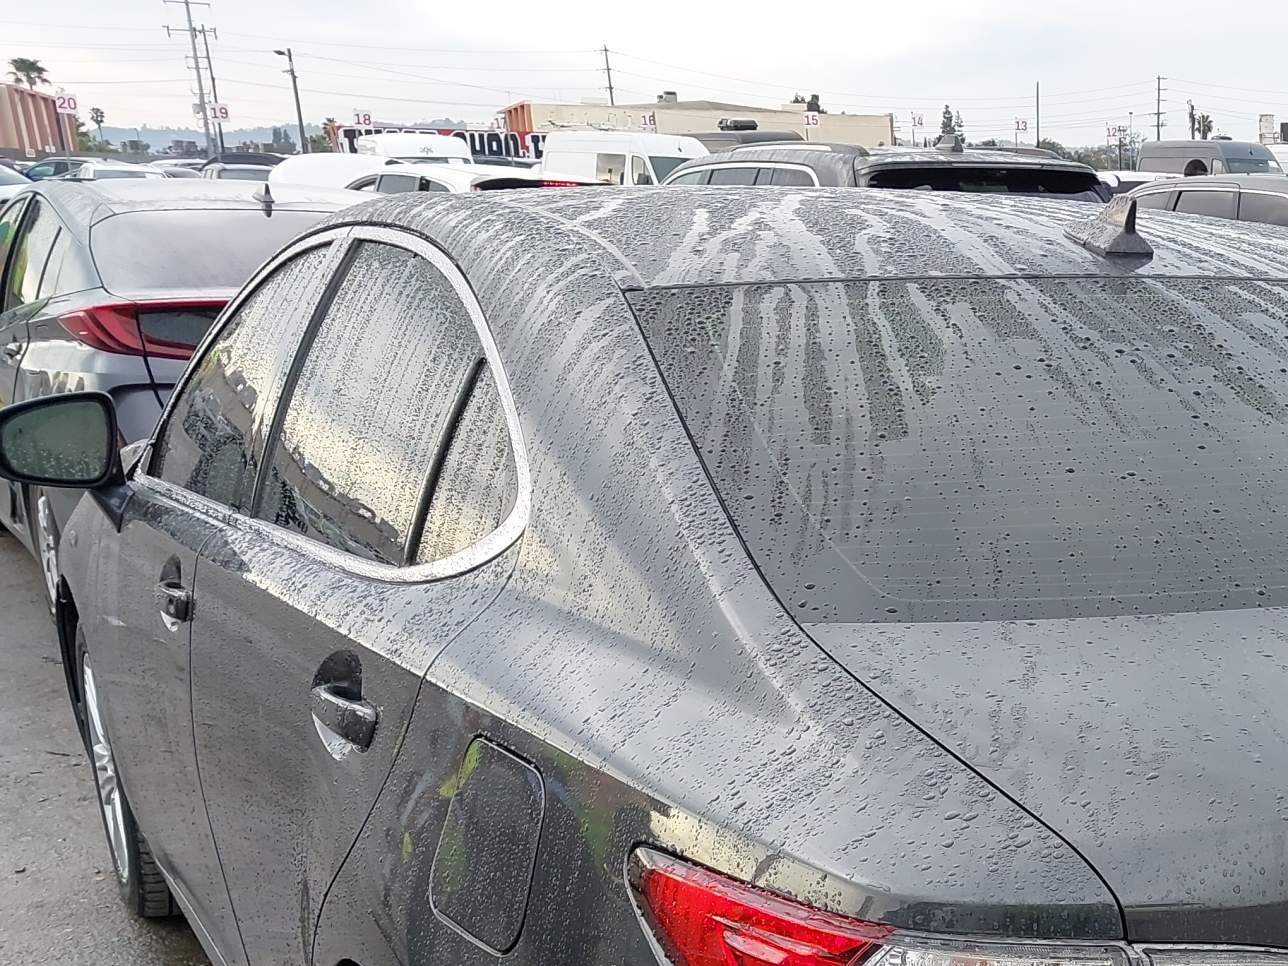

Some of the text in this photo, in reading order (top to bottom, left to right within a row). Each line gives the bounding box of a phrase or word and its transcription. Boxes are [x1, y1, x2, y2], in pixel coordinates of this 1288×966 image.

[56, 96, 77, 110] 20
[210, 106, 229, 119] 19
[354, 113, 372, 126] 18
[804, 115, 819, 126] 15
[911, 116, 923, 127] 14
[1015, 121, 1028, 131] 13
[1106, 127, 1118, 137] 12
